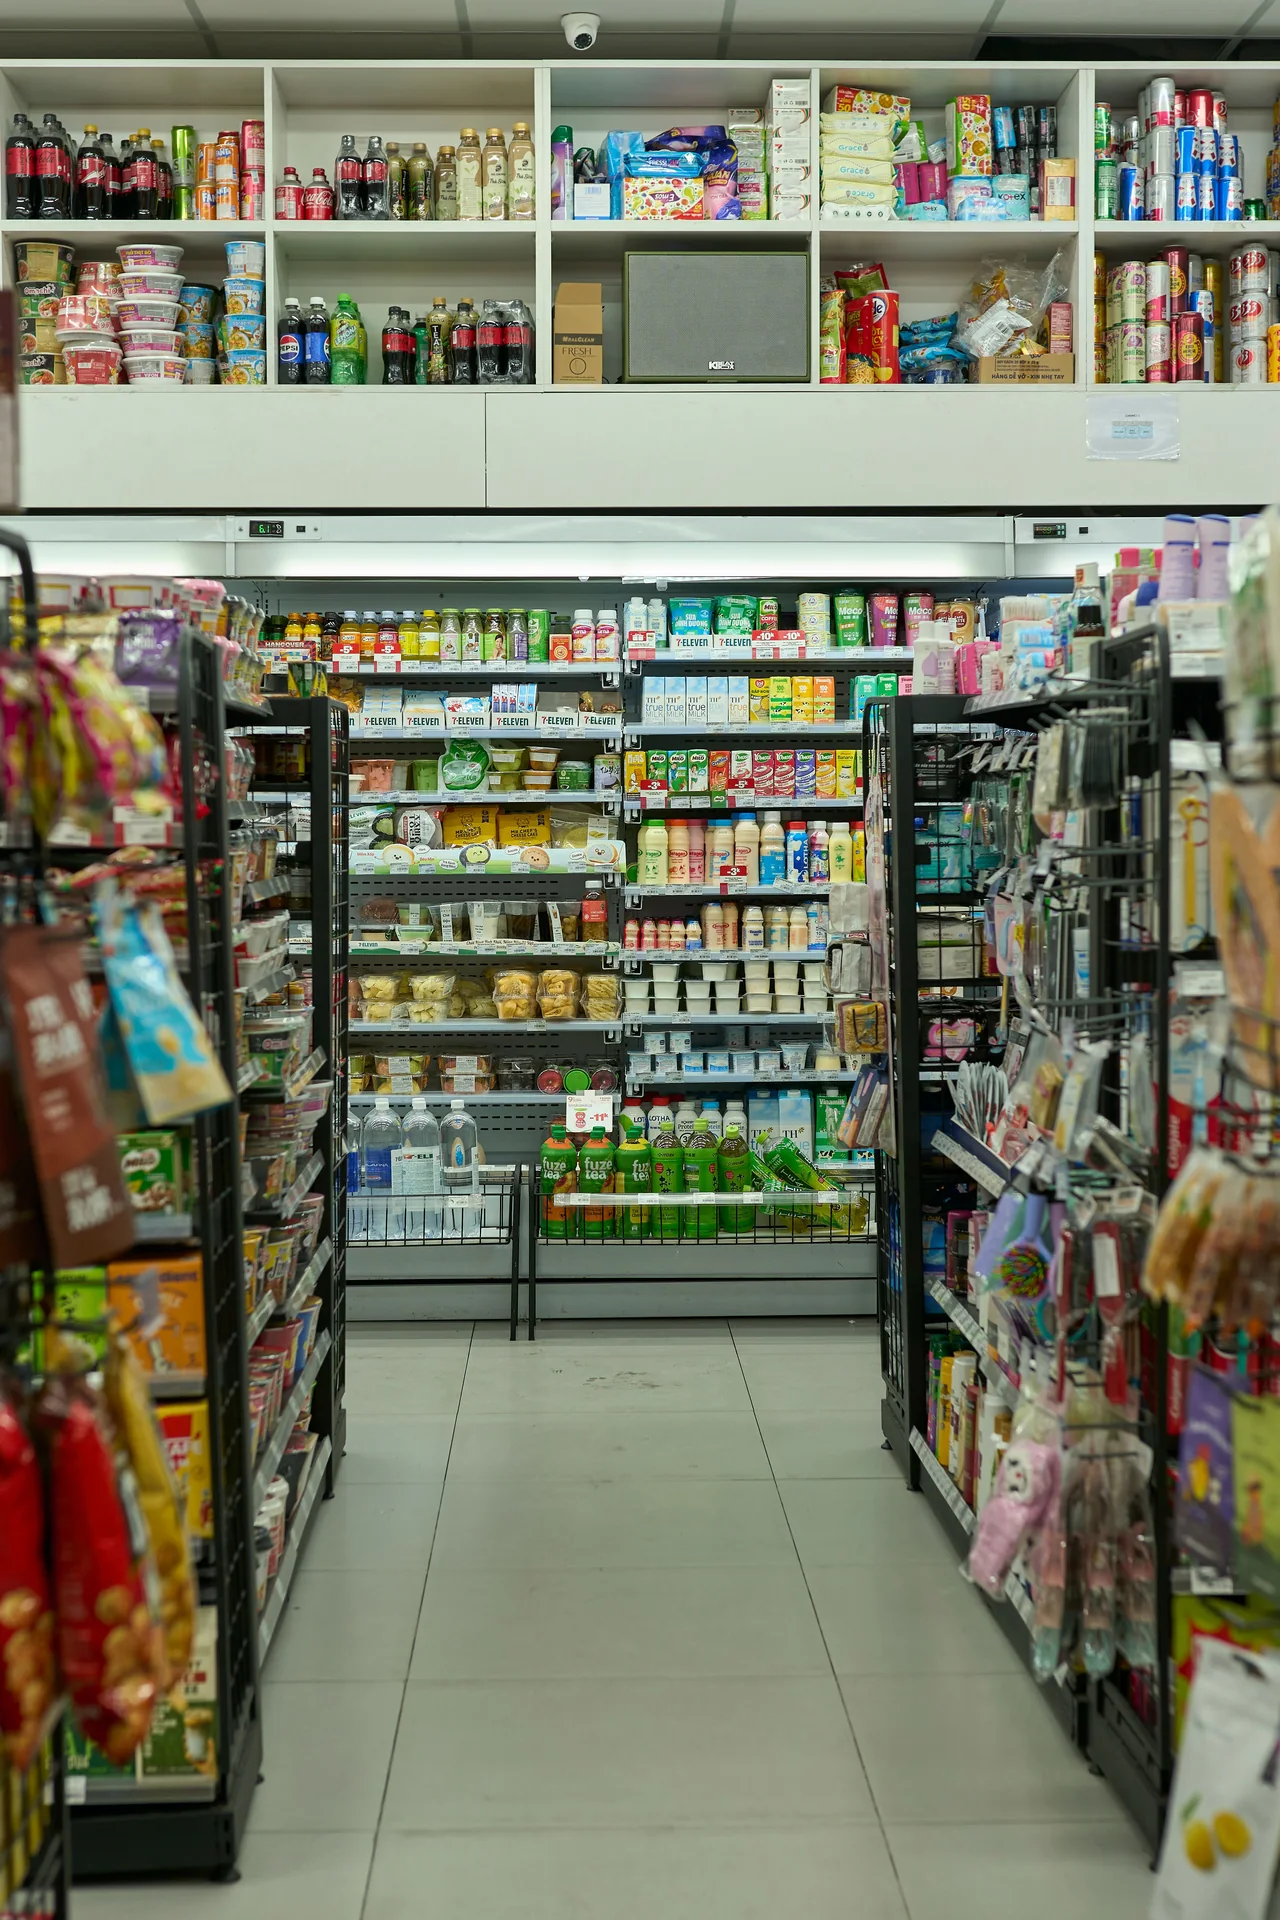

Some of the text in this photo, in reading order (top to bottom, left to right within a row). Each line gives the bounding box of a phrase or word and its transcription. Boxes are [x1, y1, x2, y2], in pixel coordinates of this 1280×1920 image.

[562, 347, 592, 356] FRESH
[1168, 1116, 1181, 1169] Colgate
[543, 1157, 566, 1170] fuze
[584, 1157, 612, 1170] fuze
[544, 1170, 560, 1179] tea
[586, 1169, 607, 1179] tea
